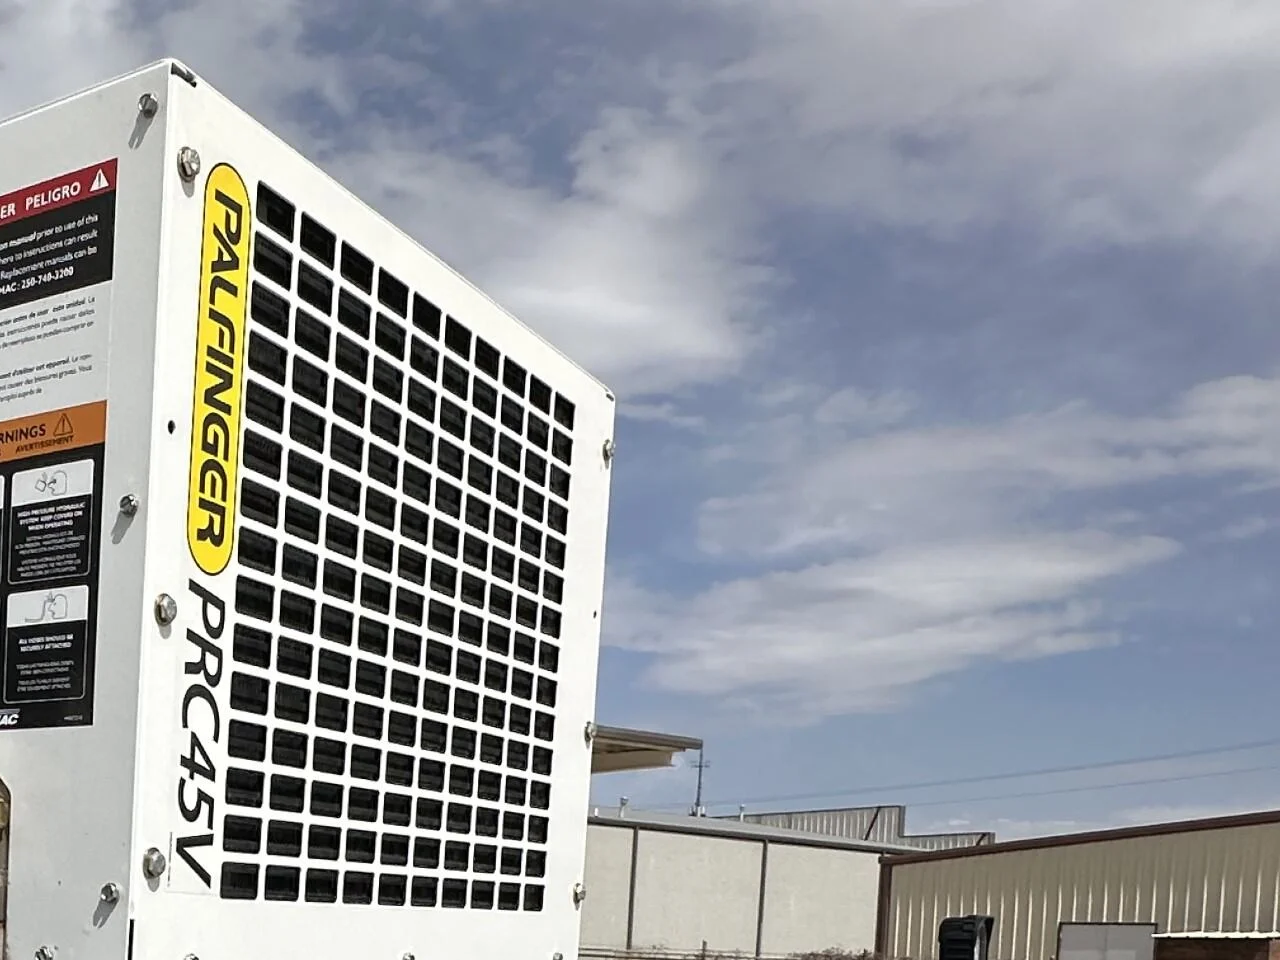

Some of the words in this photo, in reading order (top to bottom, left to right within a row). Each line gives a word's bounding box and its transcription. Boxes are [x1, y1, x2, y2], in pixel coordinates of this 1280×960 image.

[26, 181, 81, 211] PELIGRO
[37, 227, 53, 241] prior
[86, 213, 98, 226] this
[197, 186, 246, 556] PALFINGER
[177, 577, 226, 890] PRC45V
